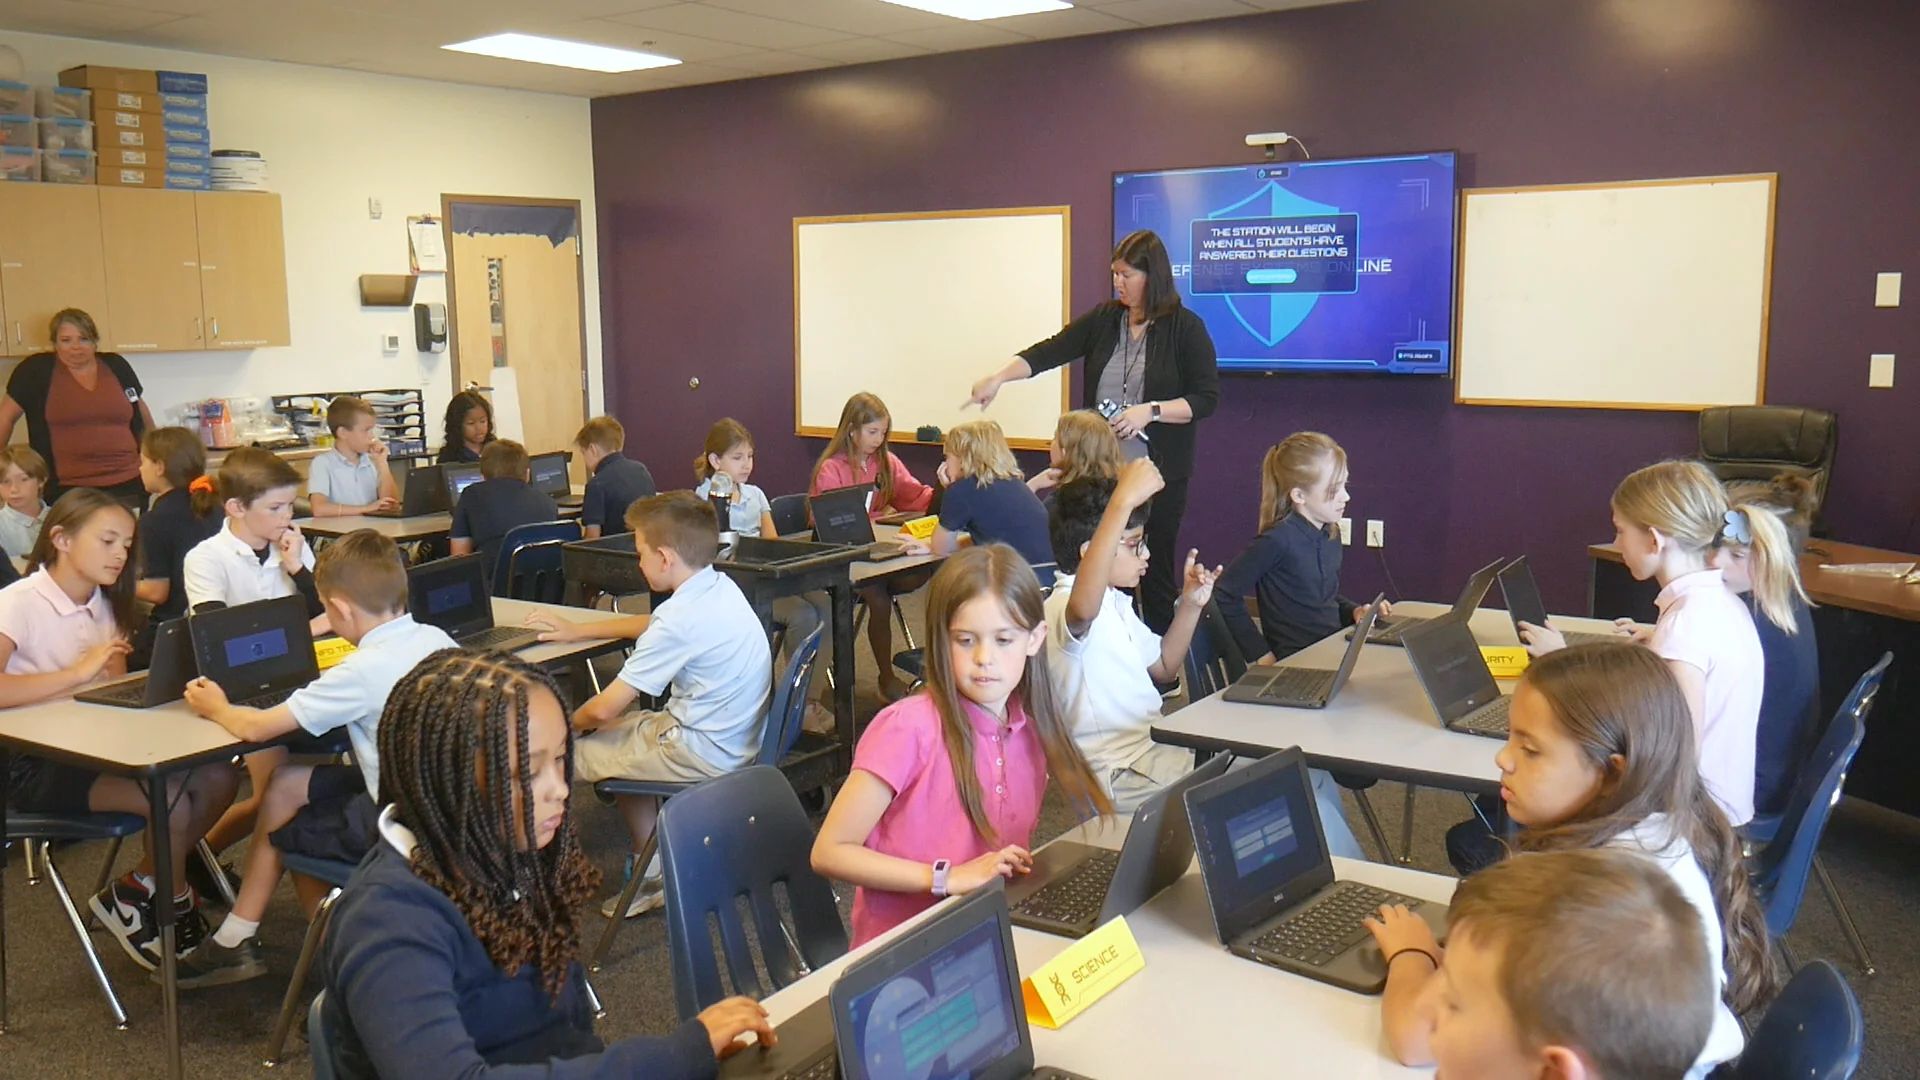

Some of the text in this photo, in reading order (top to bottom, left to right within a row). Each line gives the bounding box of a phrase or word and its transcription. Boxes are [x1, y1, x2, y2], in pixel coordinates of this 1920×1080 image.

[1211, 223, 1336, 237] THE STATION WILL BEGIN
[1202, 235, 1345, 249] WHEN ALL STUDENTS HAVE
[1199, 247, 1348, 261] ANSWERED THEIR QUESTIONS
[1171, 263, 1234, 277] EFENSE
[1327, 258, 1393, 273] ONLINE
[1071, 944, 1120, 984] SCIENCE
